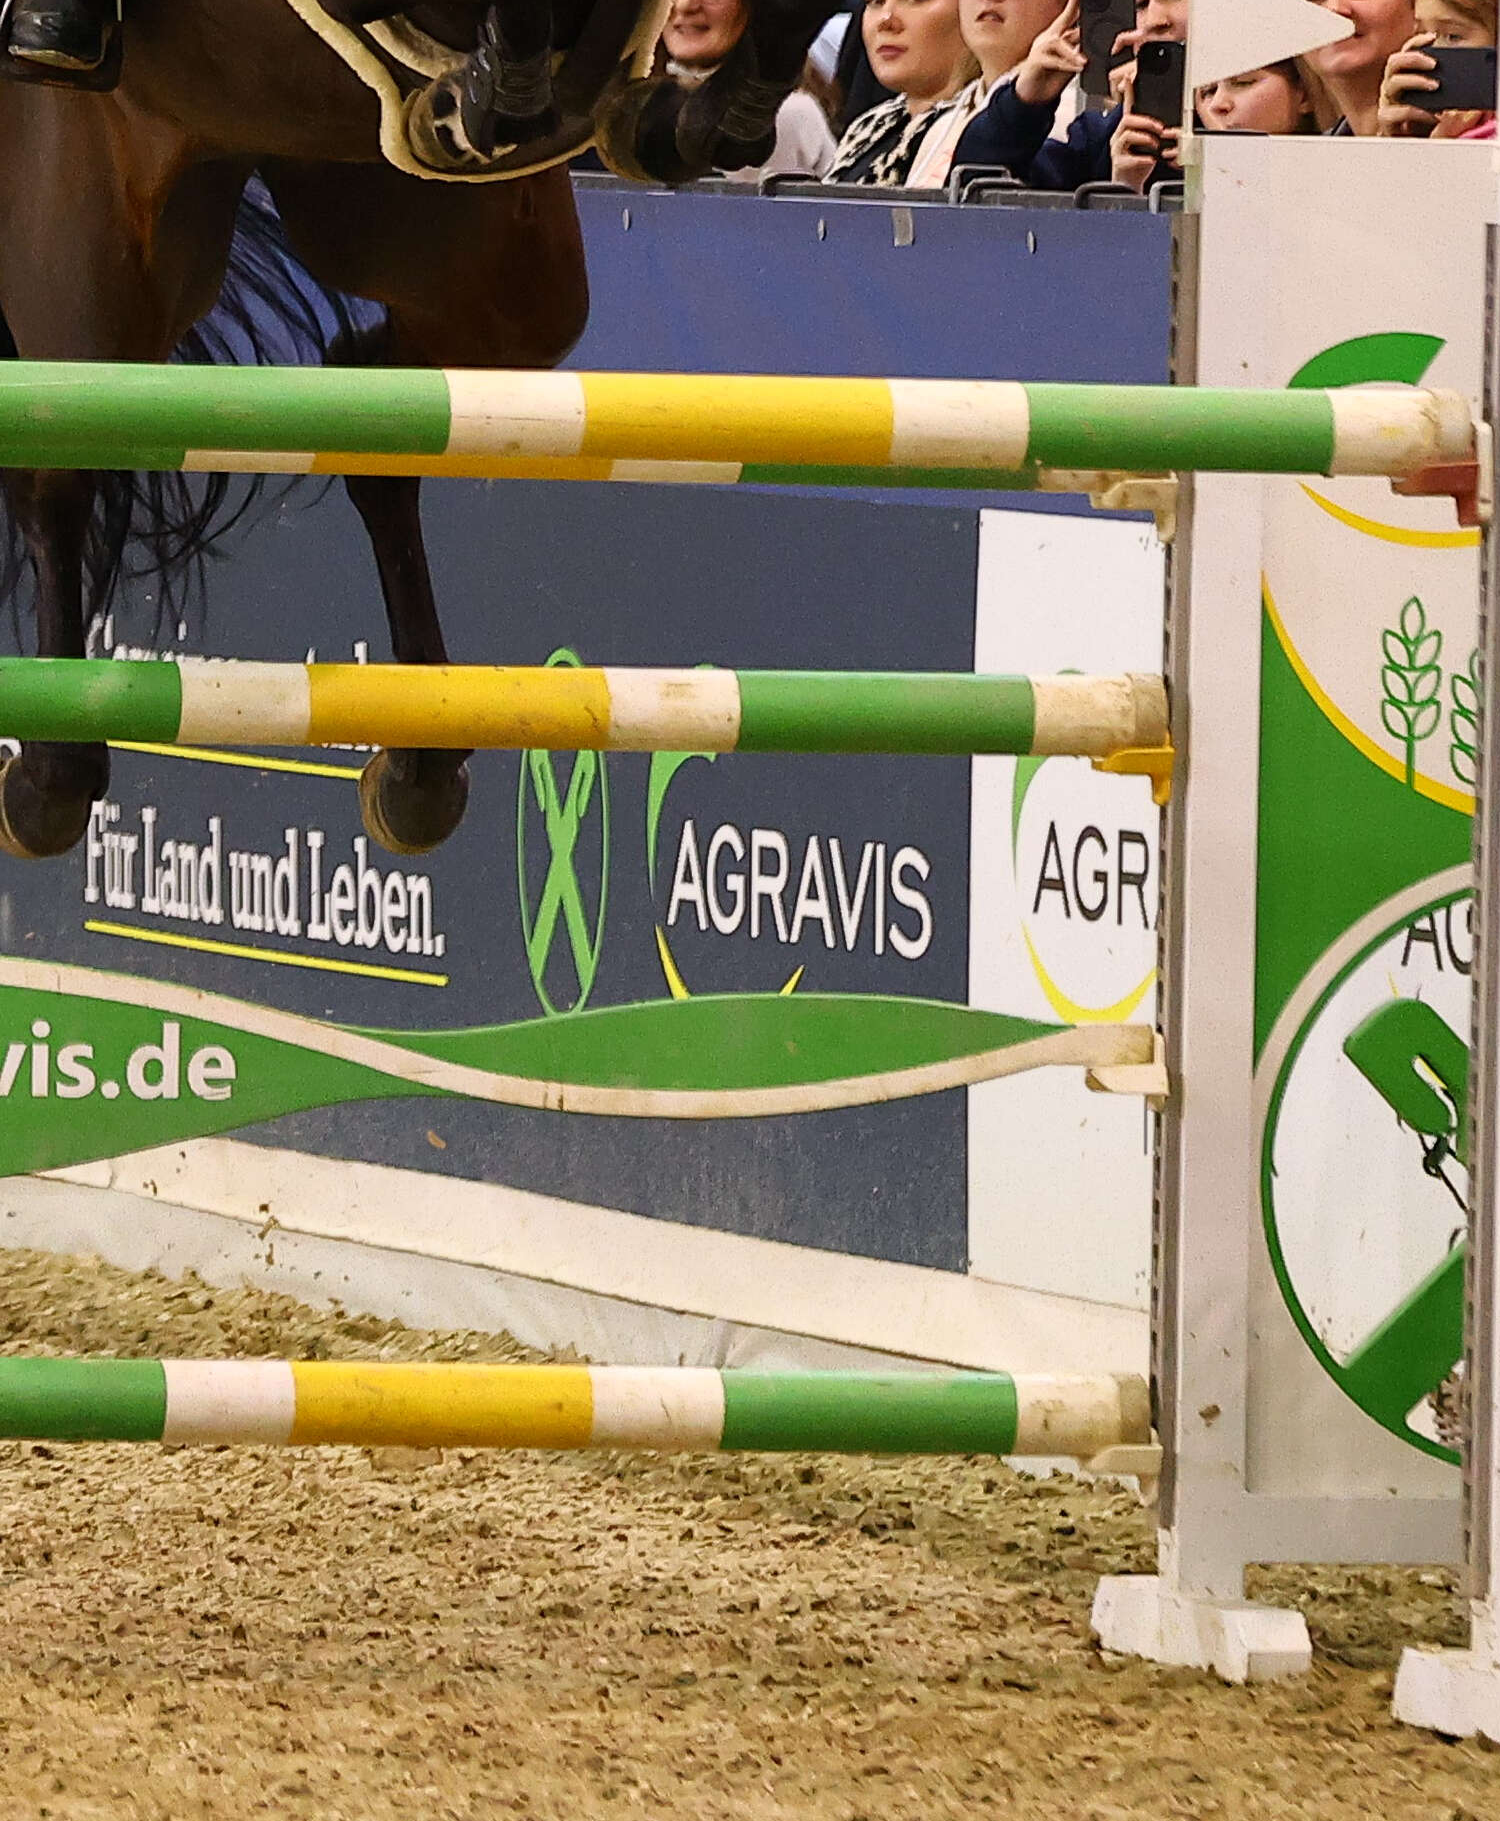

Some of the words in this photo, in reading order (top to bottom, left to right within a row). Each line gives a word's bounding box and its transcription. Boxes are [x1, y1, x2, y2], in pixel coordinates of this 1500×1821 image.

[83, 798, 138, 911] Für
[140, 804, 225, 925] Land
[228, 826, 302, 937] und
[305, 828, 446, 958] Leben.
[665, 818, 933, 960] AGRAVIS
[1032, 820, 1158, 932] AGR
